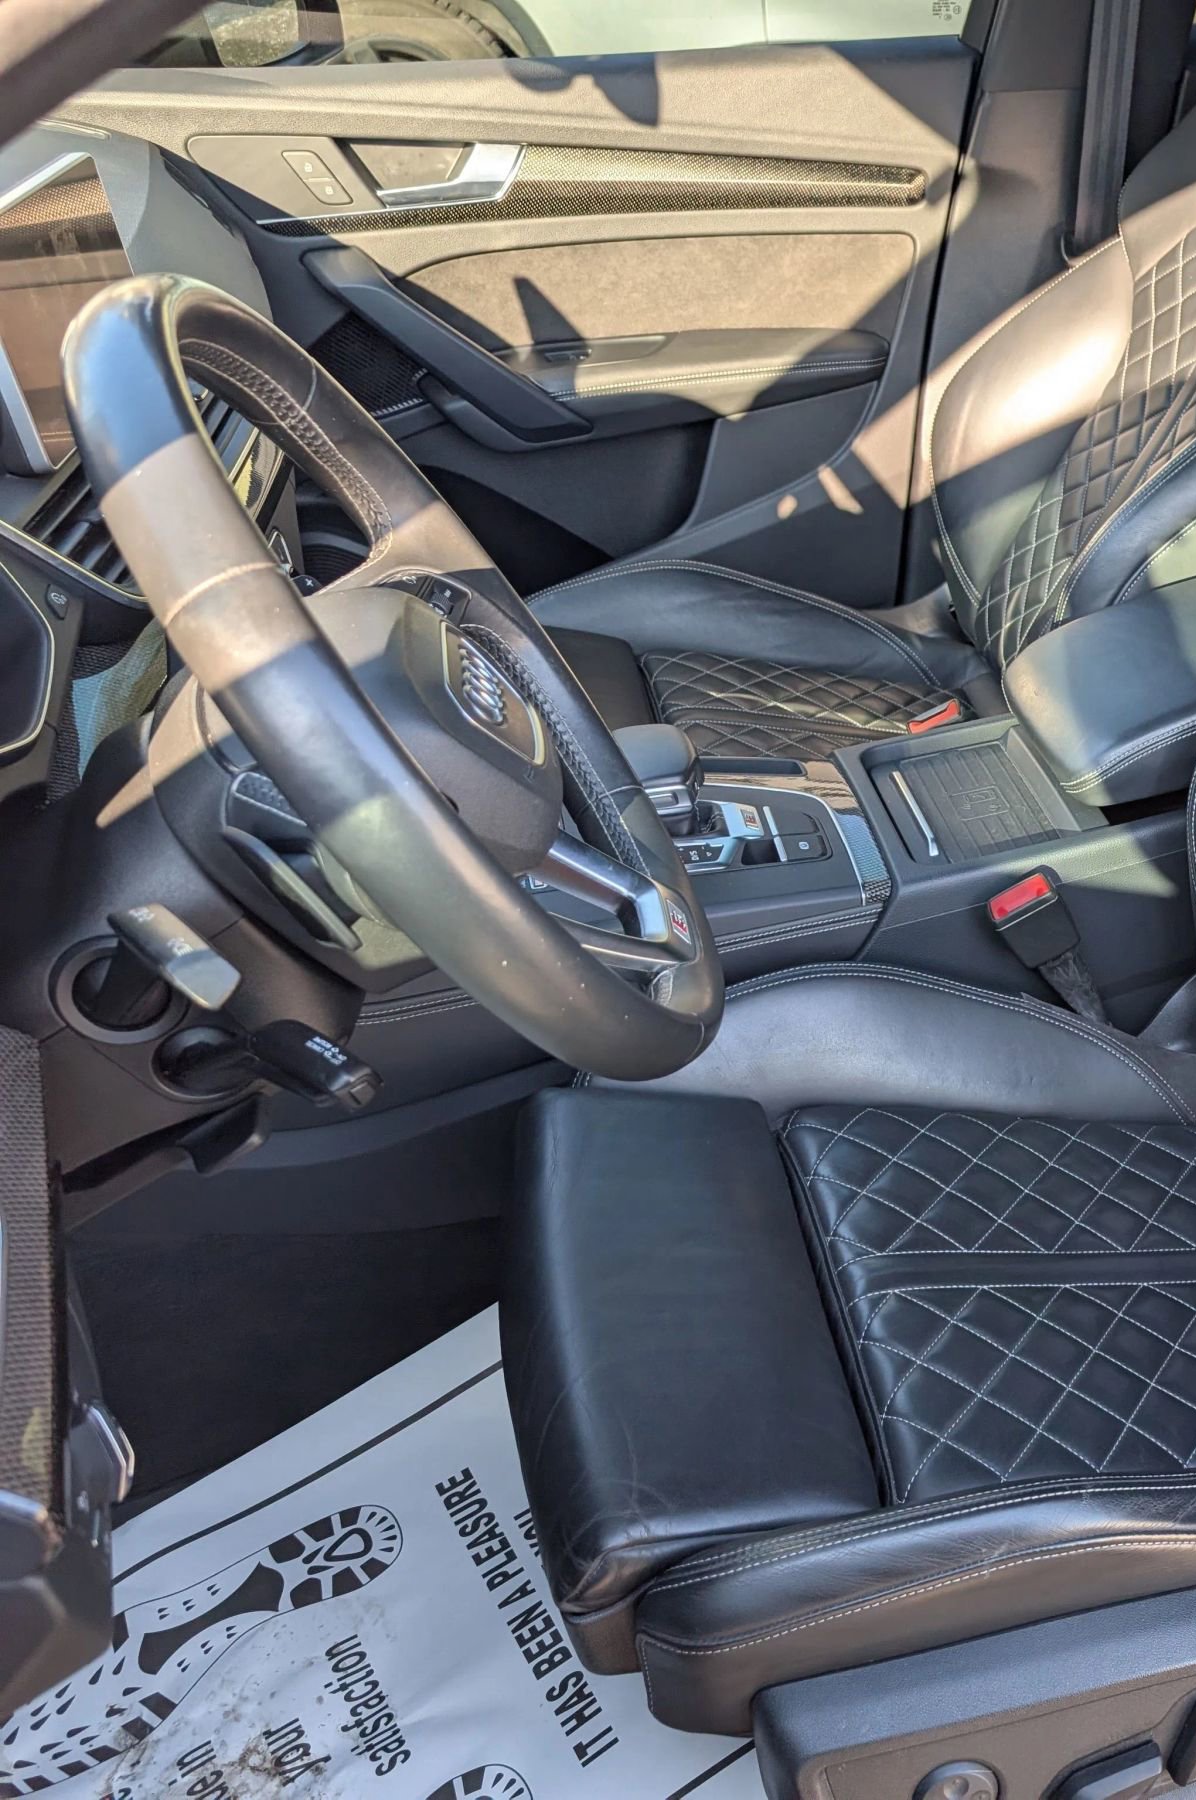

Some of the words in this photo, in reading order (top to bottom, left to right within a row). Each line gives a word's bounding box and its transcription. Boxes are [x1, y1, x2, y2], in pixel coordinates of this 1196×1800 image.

[435, 1468, 524, 1591] PLEASURE
[498, 1580, 536, 1609] A
[507, 1600, 572, 1680] BEEN
[325, 1635, 410, 1776] satisfaction
[546, 1671, 602, 1736] HAS
[169, 1741, 216, 1786] in
[263, 1719, 331, 1786] your
[573, 1726, 619, 1767] IT
